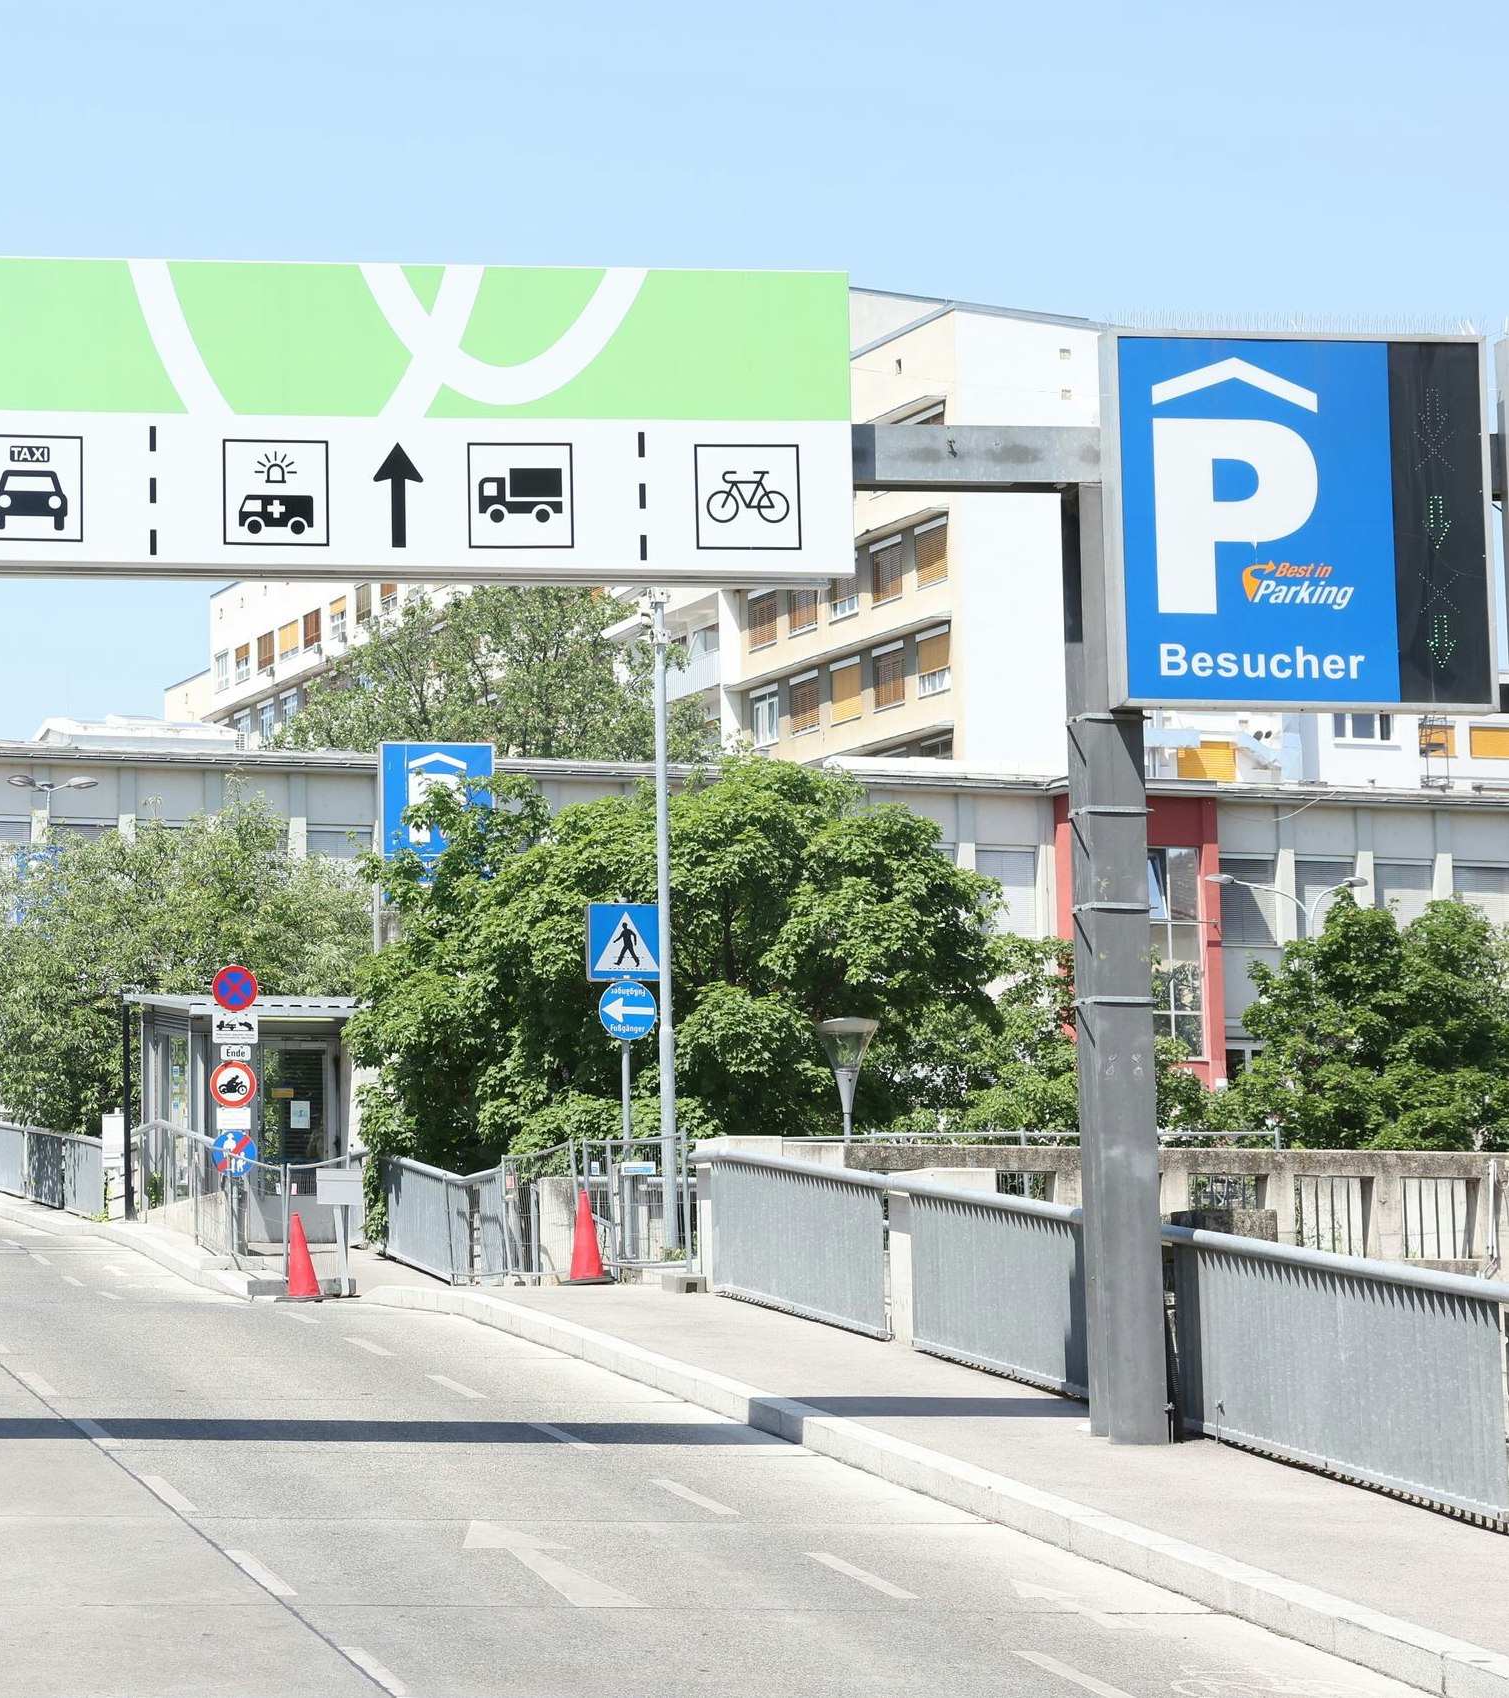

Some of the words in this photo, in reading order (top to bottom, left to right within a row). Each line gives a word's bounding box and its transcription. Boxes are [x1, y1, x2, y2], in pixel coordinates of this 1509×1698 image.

[10, 446, 49, 462] TAXI
[1152, 417, 1319, 615] P
[1275, 562, 1315, 579] Best
[1314, 562, 1333, 578] in
[1253, 579, 1355, 611] Parking
[1159, 642, 1366, 680] Besucher
[610, 1024, 645, 1033] Fußgänger
[226, 1049, 245, 1057] Ende
